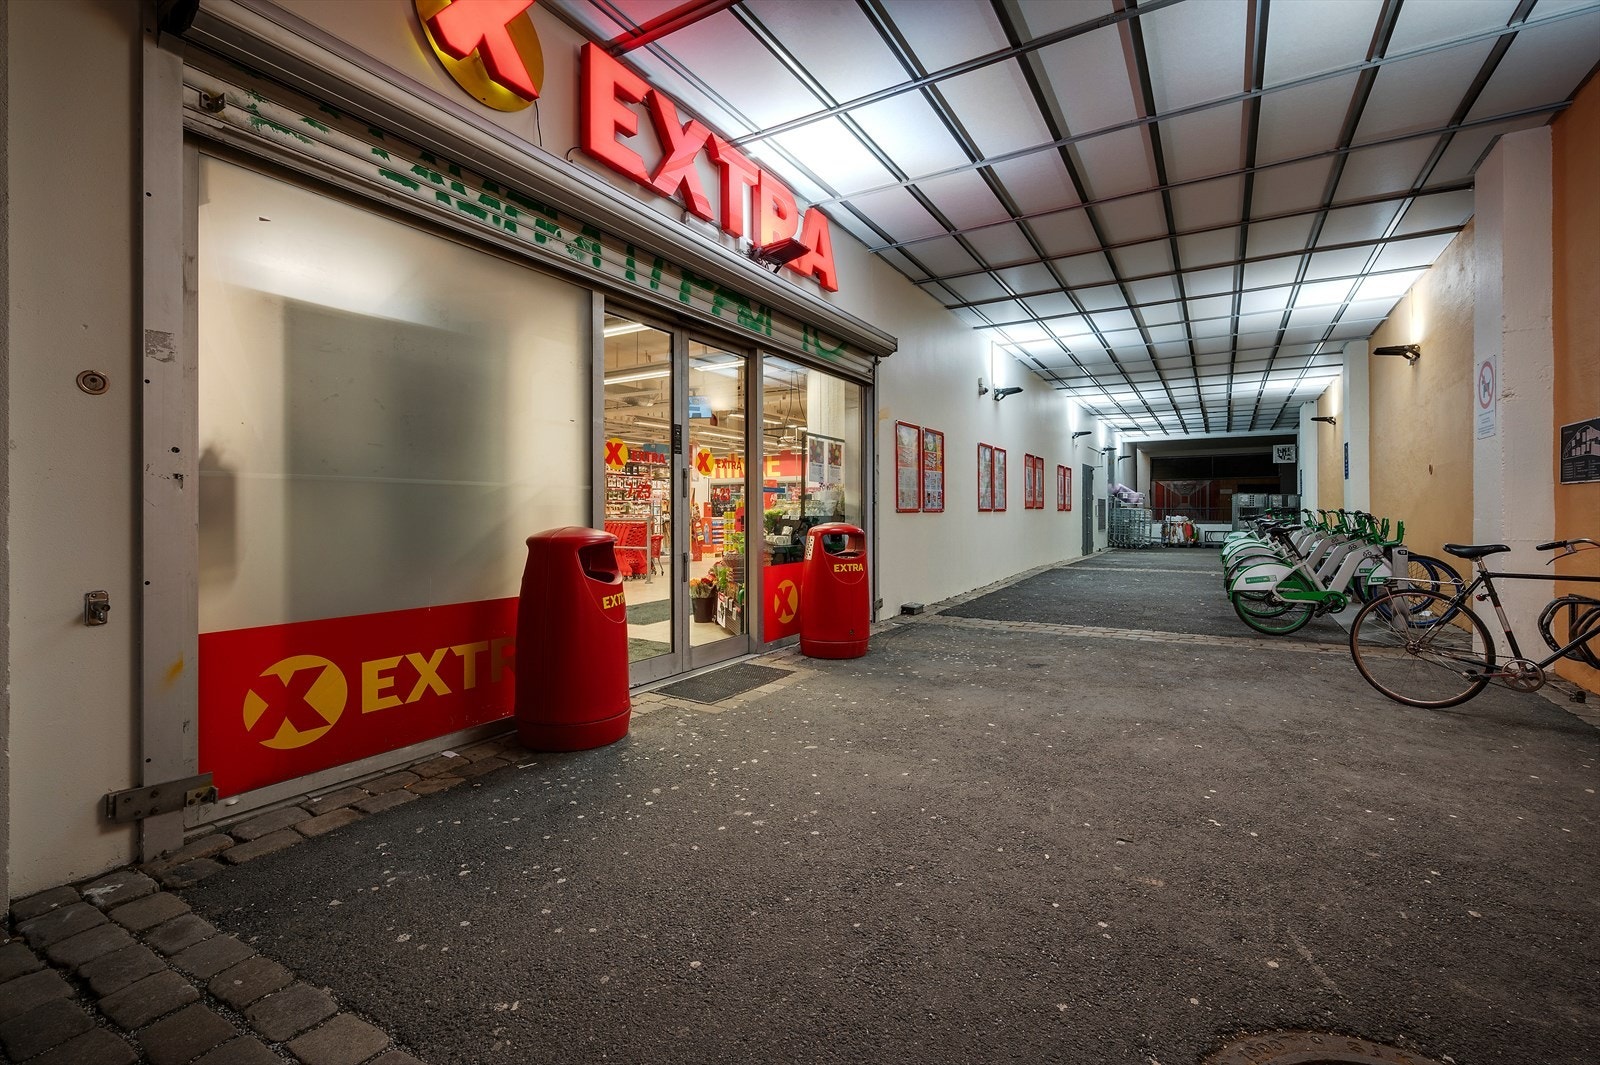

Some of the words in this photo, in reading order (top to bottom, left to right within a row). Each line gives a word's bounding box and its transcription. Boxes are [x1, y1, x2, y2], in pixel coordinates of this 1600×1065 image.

[580, 41, 838, 292] EXTRA
[631, 449, 667, 464] EXTRA
[716, 458, 742, 471] EXTRA
[833, 564, 864, 573] EXTRA
[602, 592, 626, 609] EXTR
[361, 637, 516, 714] EXTR
